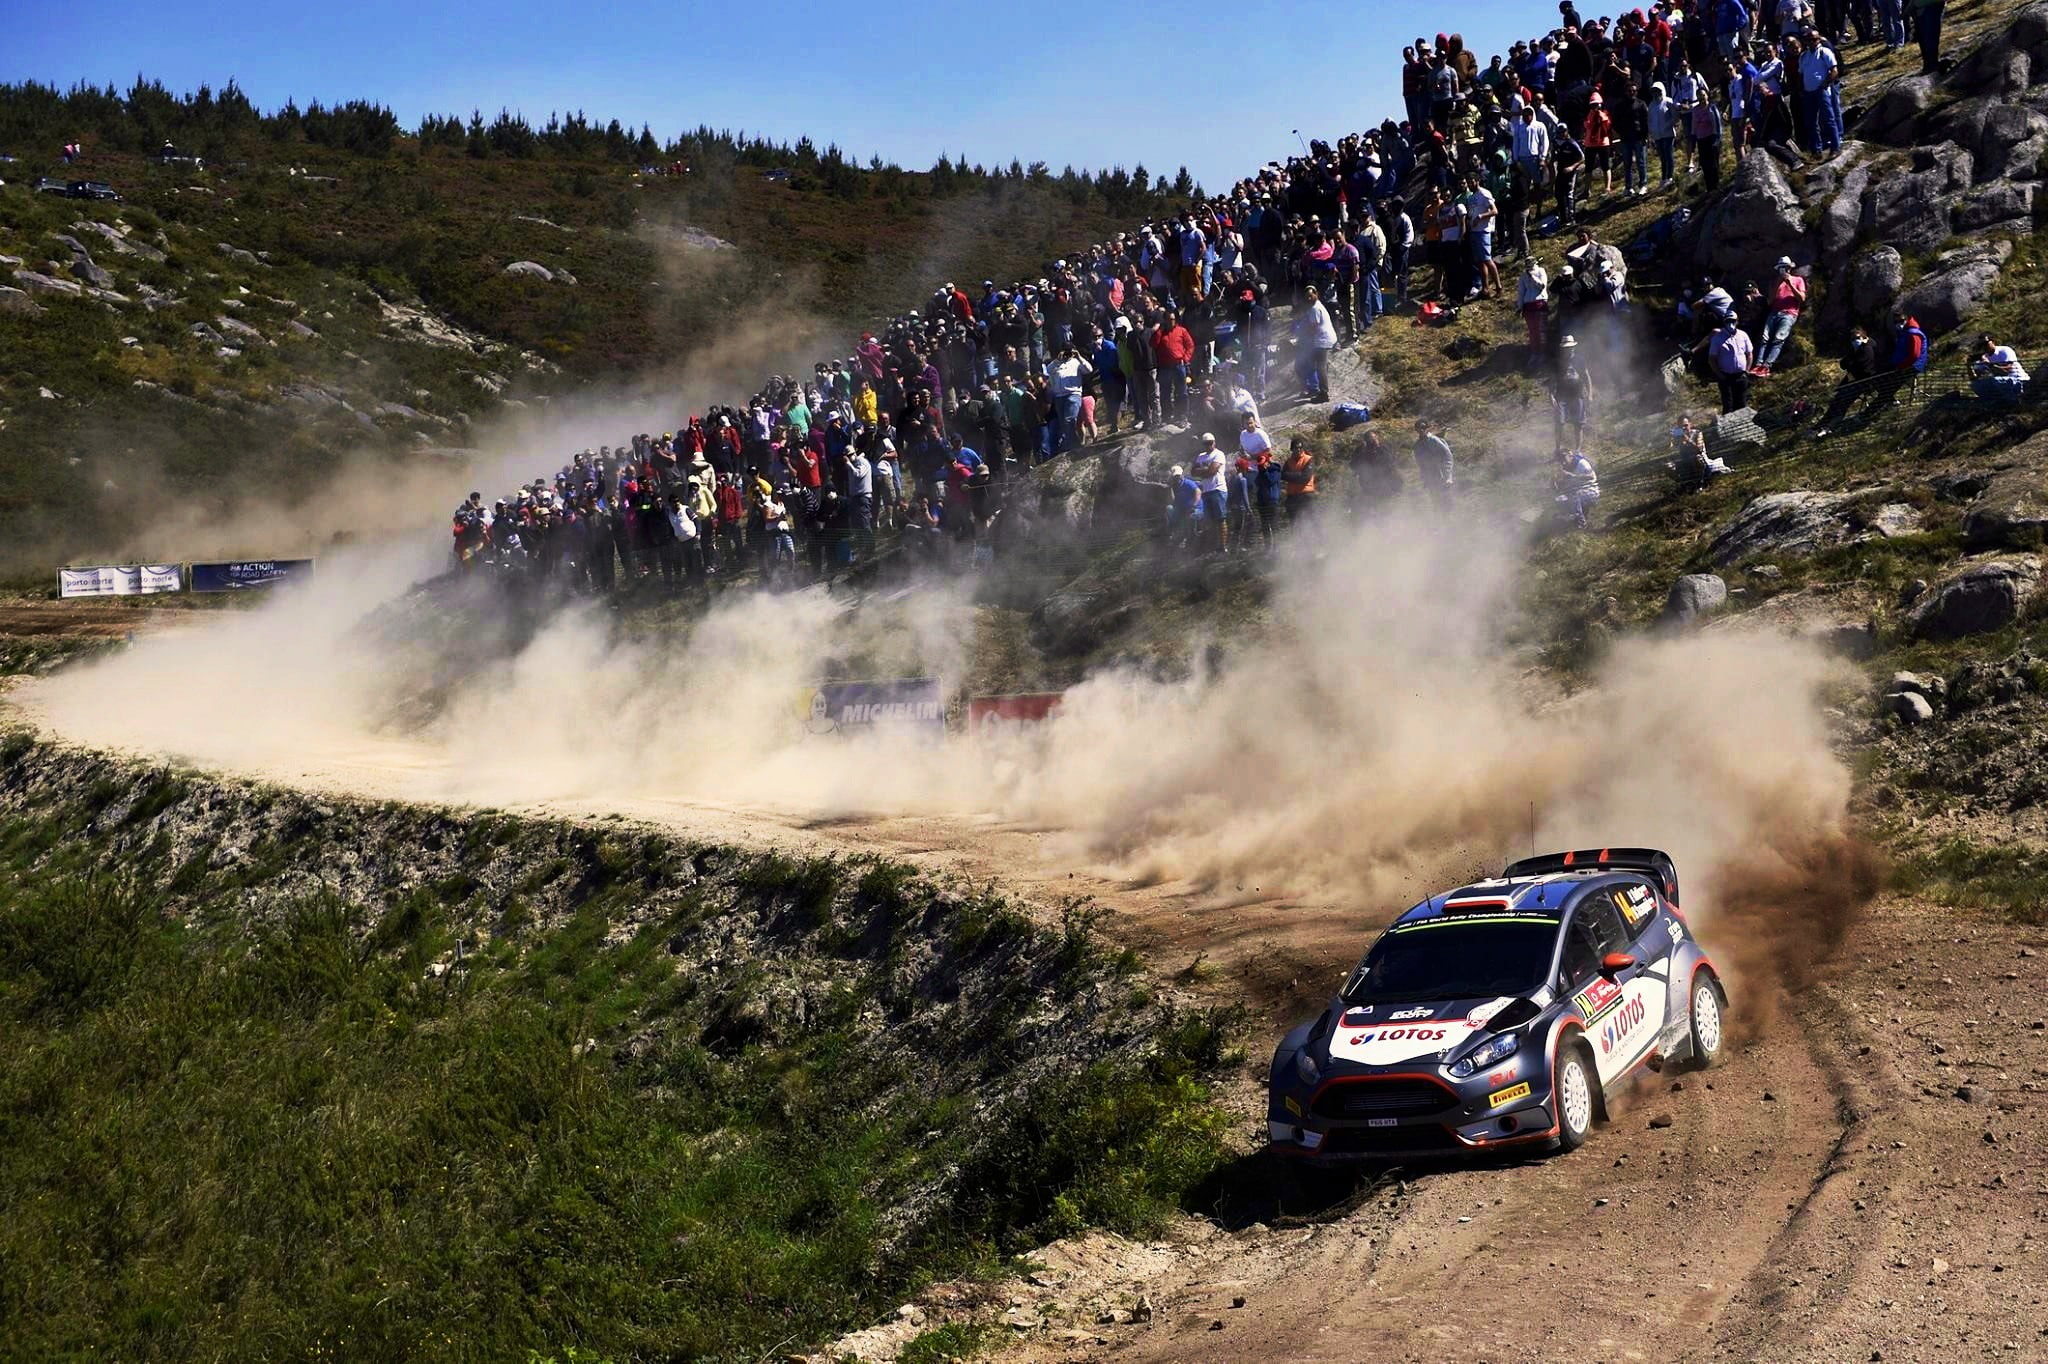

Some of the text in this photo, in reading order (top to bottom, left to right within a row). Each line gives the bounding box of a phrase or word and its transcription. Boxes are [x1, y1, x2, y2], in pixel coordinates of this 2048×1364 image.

[243, 562, 274, 571] ACTION
[66, 577, 113, 587] porto norte
[840, 702, 938, 722] MICHELIN
[1614, 891, 1637, 925] 14
[1574, 993, 1596, 1018] 14
[1613, 992, 1645, 1042] LOTOS
[1377, 1029, 1447, 1041] LOTOS
